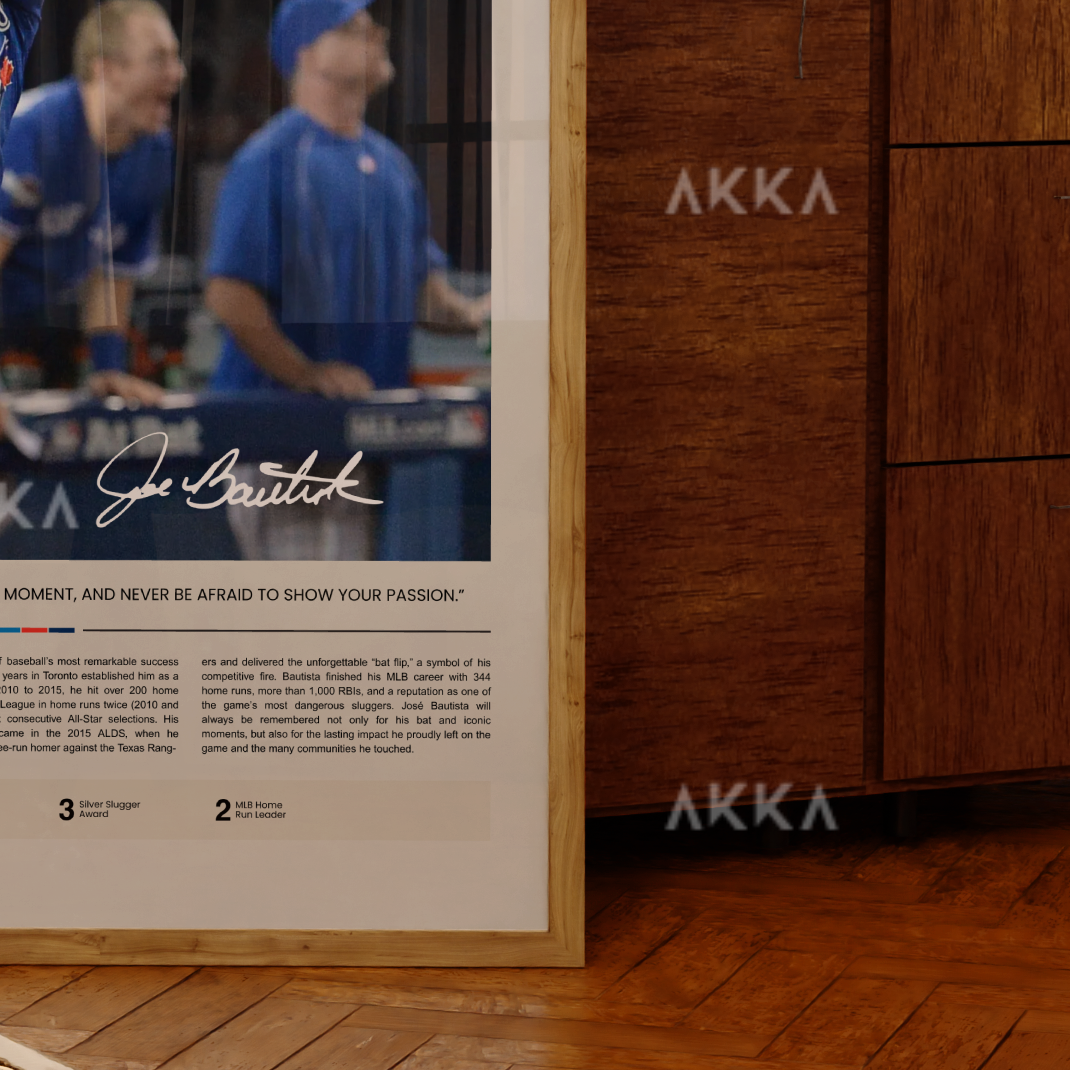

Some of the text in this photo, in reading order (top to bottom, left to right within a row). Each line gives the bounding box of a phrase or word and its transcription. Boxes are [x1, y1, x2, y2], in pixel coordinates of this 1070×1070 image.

[4, 587, 77, 603] MOMENT,
[82, 588, 115, 600] AND
[121, 588, 169, 601] NEVER
[175, 588, 192, 601] BE
[197, 588, 253, 601] AFRAID
[258, 588, 279, 601] TO
[284, 588, 334, 601] SHOW
[338, 588, 381, 601] YOUR
[387, 589, 464, 602] PASSION.”
[24, 686, 33, 694] to
[38, 686, 64, 695] 2015,
[70, 686, 82, 694] he
[87, 686, 99, 694] hit
[129, 686, 147, 694] 200
[153, 686, 179, 694] home
[202, 701, 490, 712] the game's most dangerous sluggers. José Bautista will
[31, 743, 61, 752] homer
[63, 744, 97, 754] against
[100, 744, 115, 752] the
[117, 743, 145, 752] Texas
[148, 744, 176, 754] Rang-
[59, 798, 75, 821] 3
[79, 800, 141, 811] Silver Slugger
[215, 798, 231, 821] 2
[235, 801, 283, 809] MLB Home
[79, 810, 109, 818] Award
[235, 811, 287, 819] Run Leader
